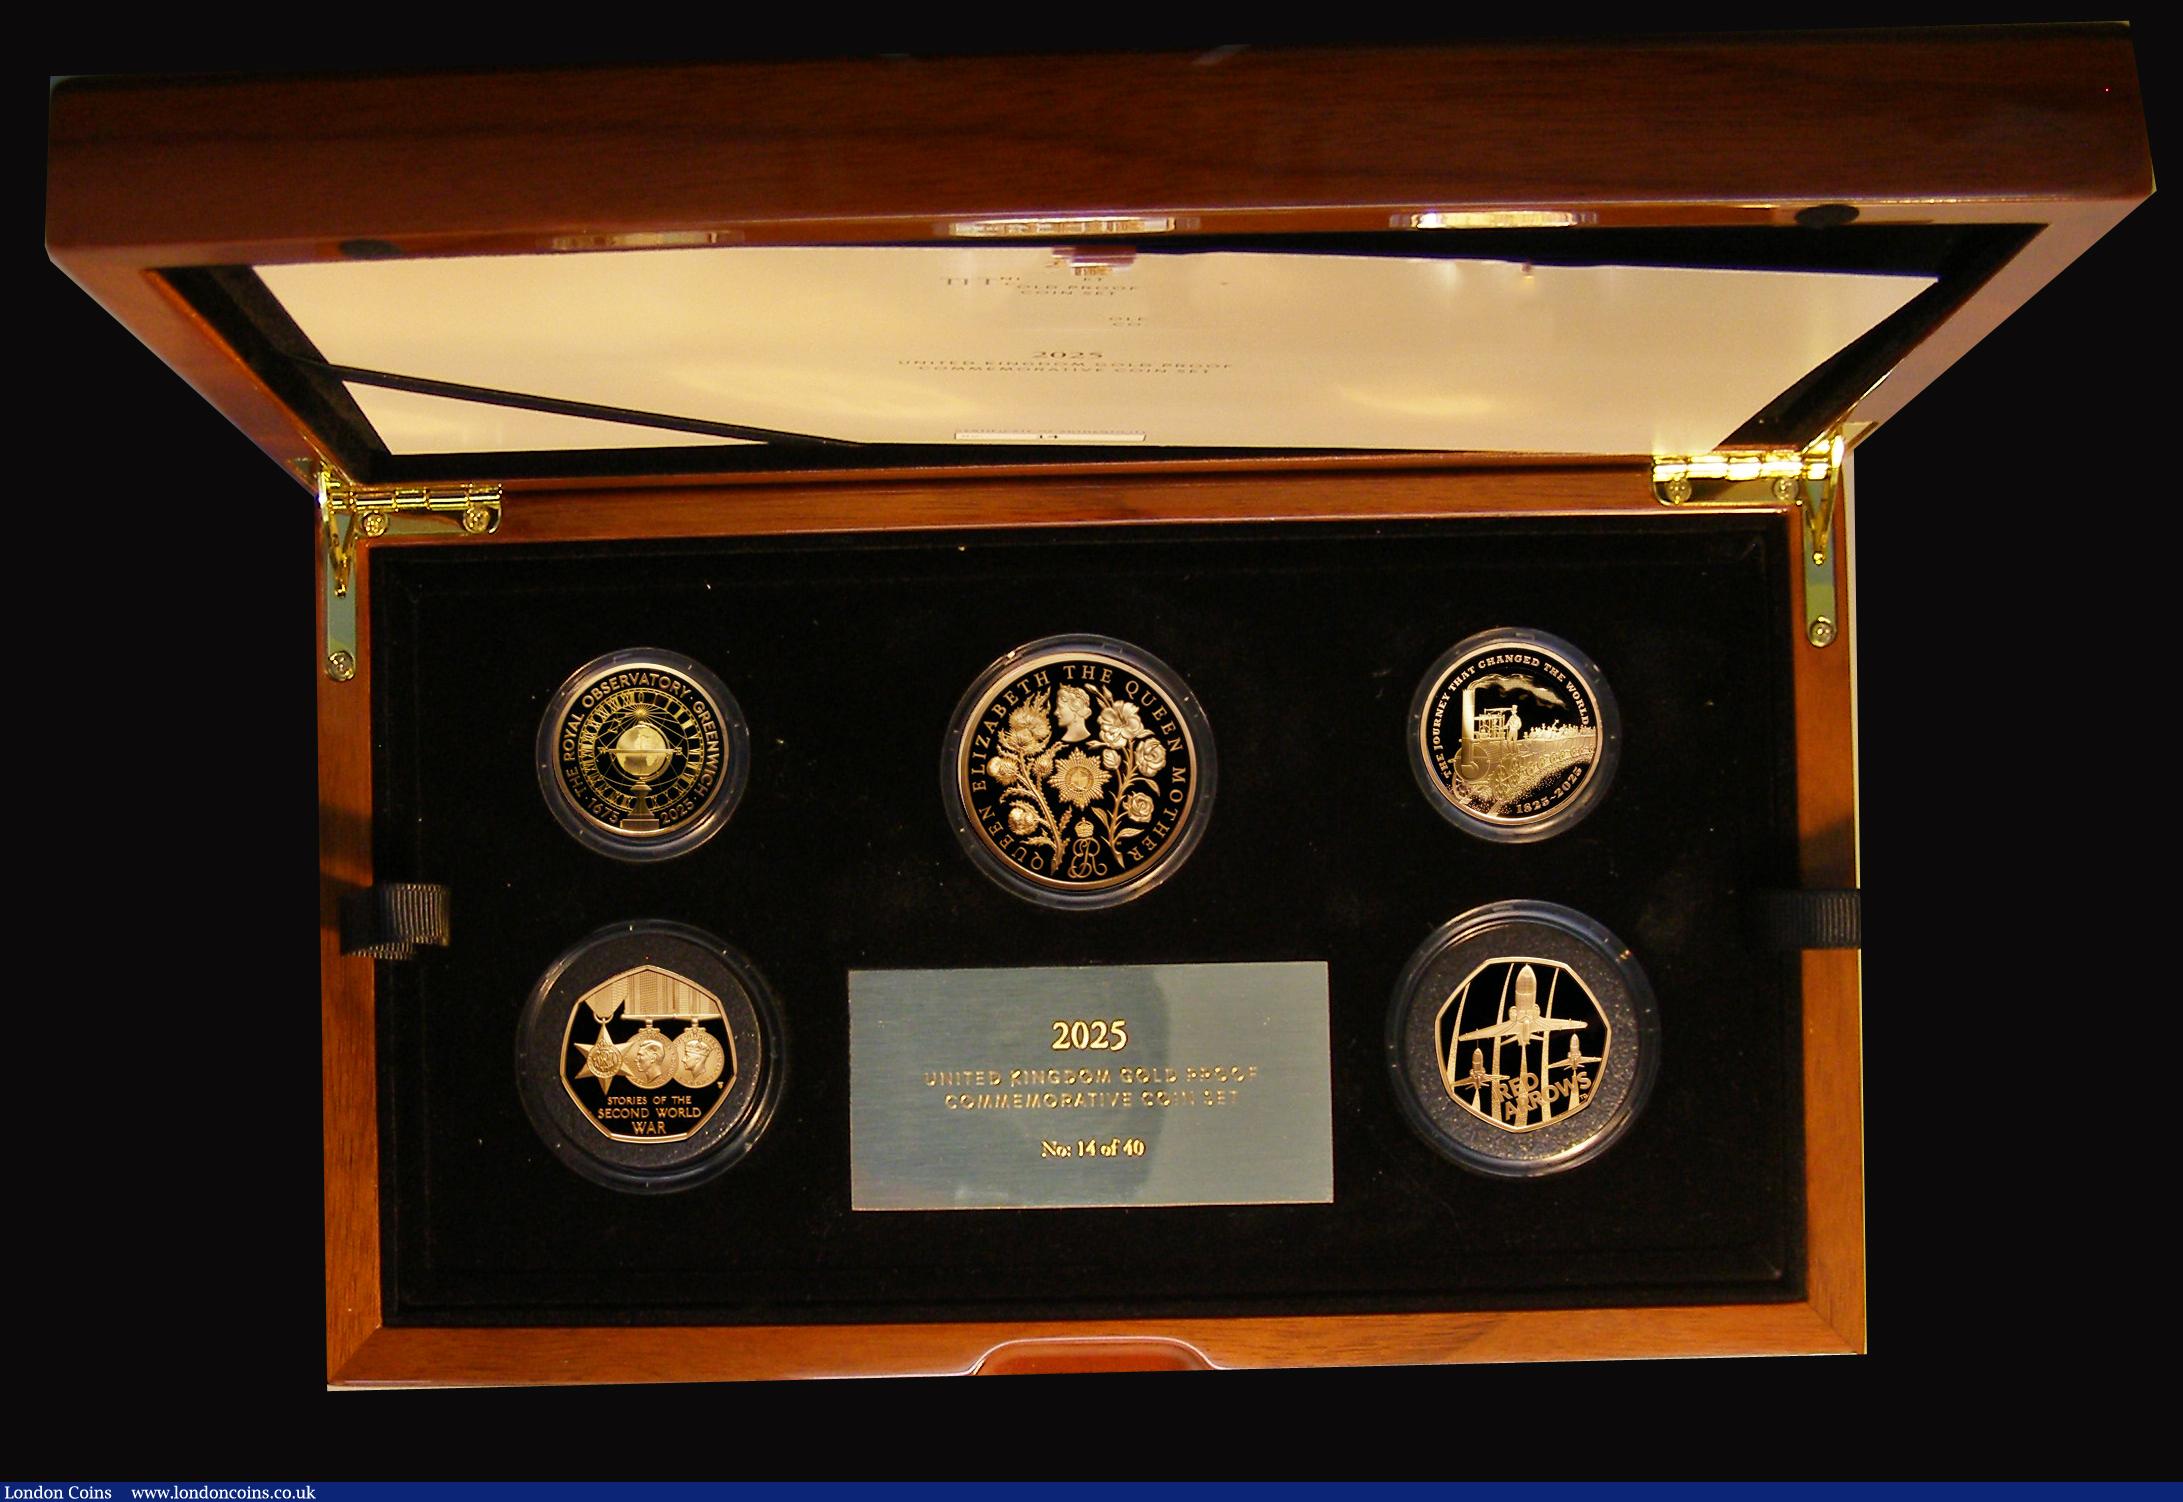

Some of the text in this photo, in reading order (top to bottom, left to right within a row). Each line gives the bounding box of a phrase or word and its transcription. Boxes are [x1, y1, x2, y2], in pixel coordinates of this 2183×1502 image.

[1032, 352, 1103, 360] 2025
[581, 672, 692, 708] OBSERVATORY
[1432, 654, 1590, 780] THE JOURNEY THAT CHANGED THE WORLD
[562, 712, 585, 762] ROYAL
[692, 701, 720, 797] GREENWICH
[565, 766, 584, 798] THE
[971, 665, 1186, 870] QUEEN ELIZABETH THE QUEEN MOTHER
[587, 797, 621, 824] 1675
[660, 799, 695, 824] 2025
[1051, 1019, 1129, 1051] 2025
[924, 1066, 1258, 1087] UNITED KINGDOM GOLD PROOF
[1497, 1072, 1539, 1103] RED
[607, 1095, 692, 1106] STORIES OF THE
[944, 1089, 1239, 1110] COMMEMORATIVE COIN SET
[1505, 1071, 1592, 1121] ARROWS
[597, 1107, 702, 1119] SECOND WORLD
[631, 1121, 667, 1135] WAR
[1041, 1137, 1146, 1158] No: 14 of 40
